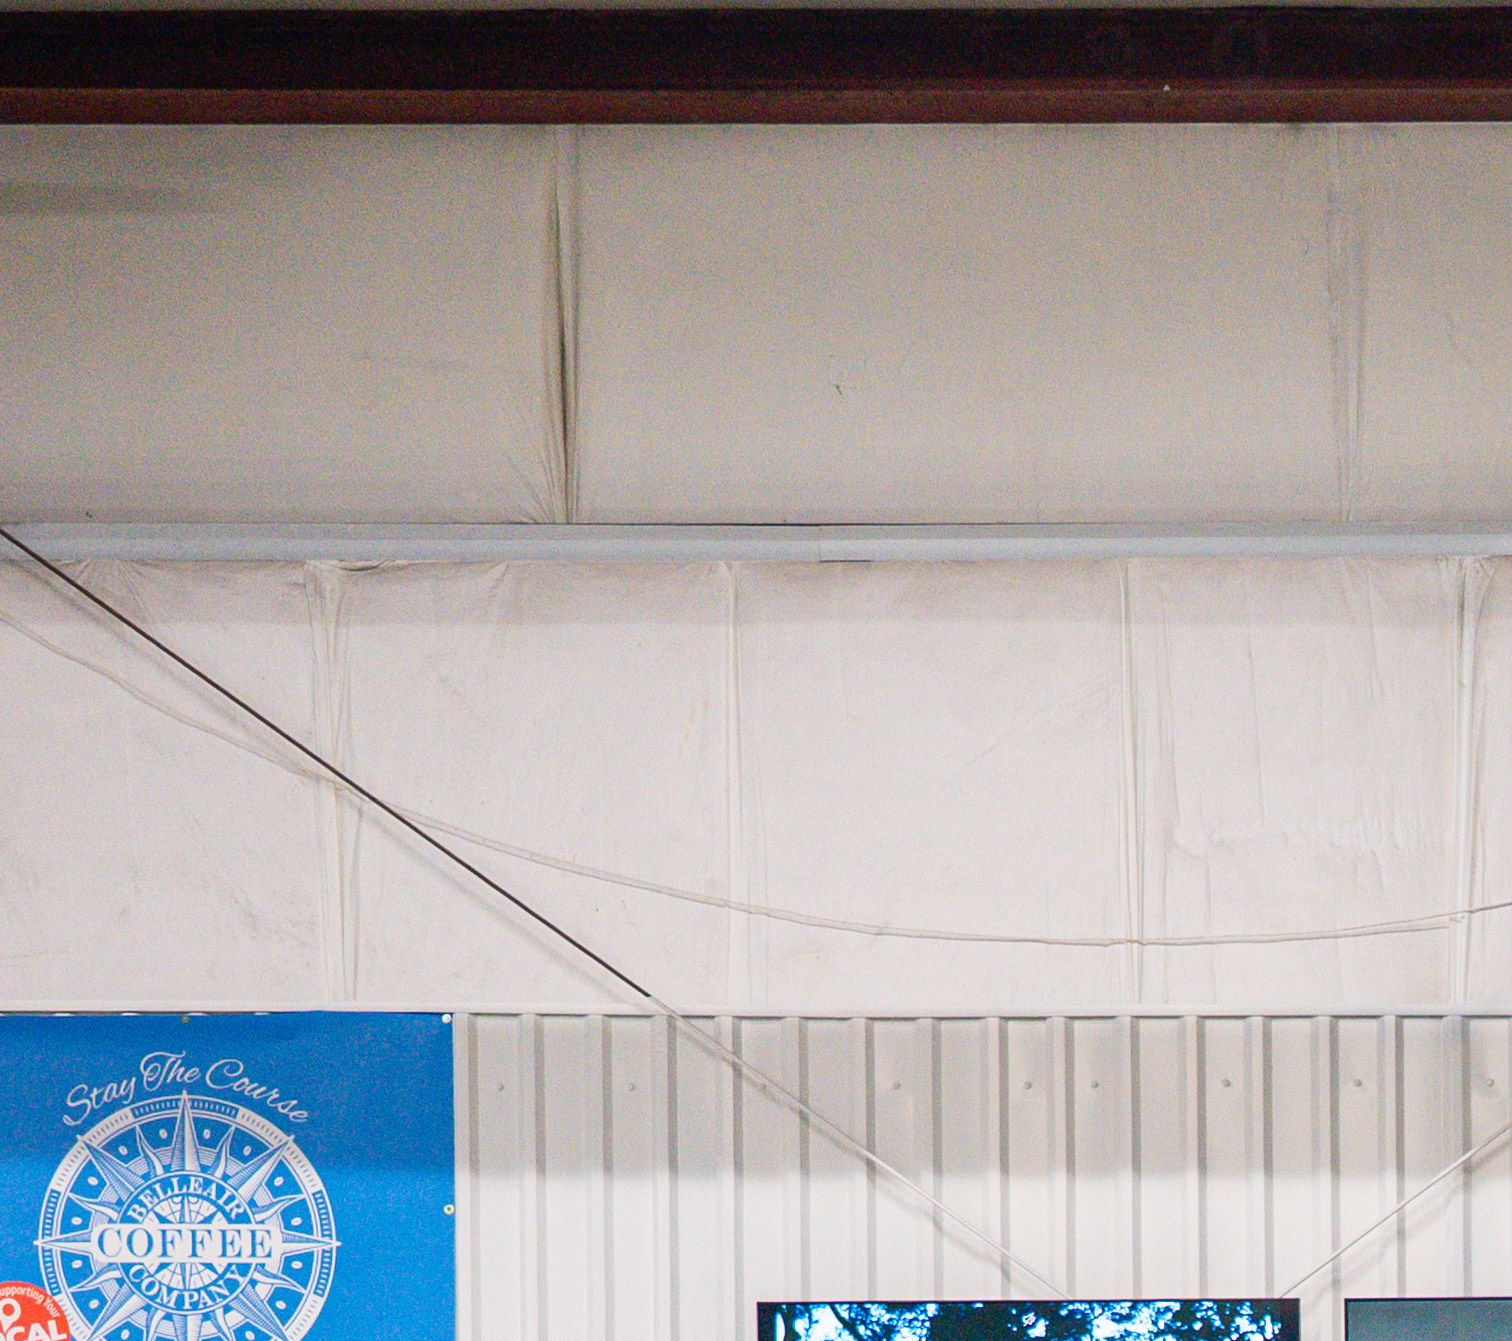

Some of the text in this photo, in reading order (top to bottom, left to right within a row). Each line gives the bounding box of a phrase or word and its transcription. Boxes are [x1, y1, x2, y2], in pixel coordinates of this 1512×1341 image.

[63, 1051, 309, 1126] Stay The Course
[127, 1177, 244, 1220] BELLEAIR
[97, 1228, 273, 1258] COFFEE
[43, 1296, 61, 1318] Your
[129, 1264, 247, 1310] COMPANY
